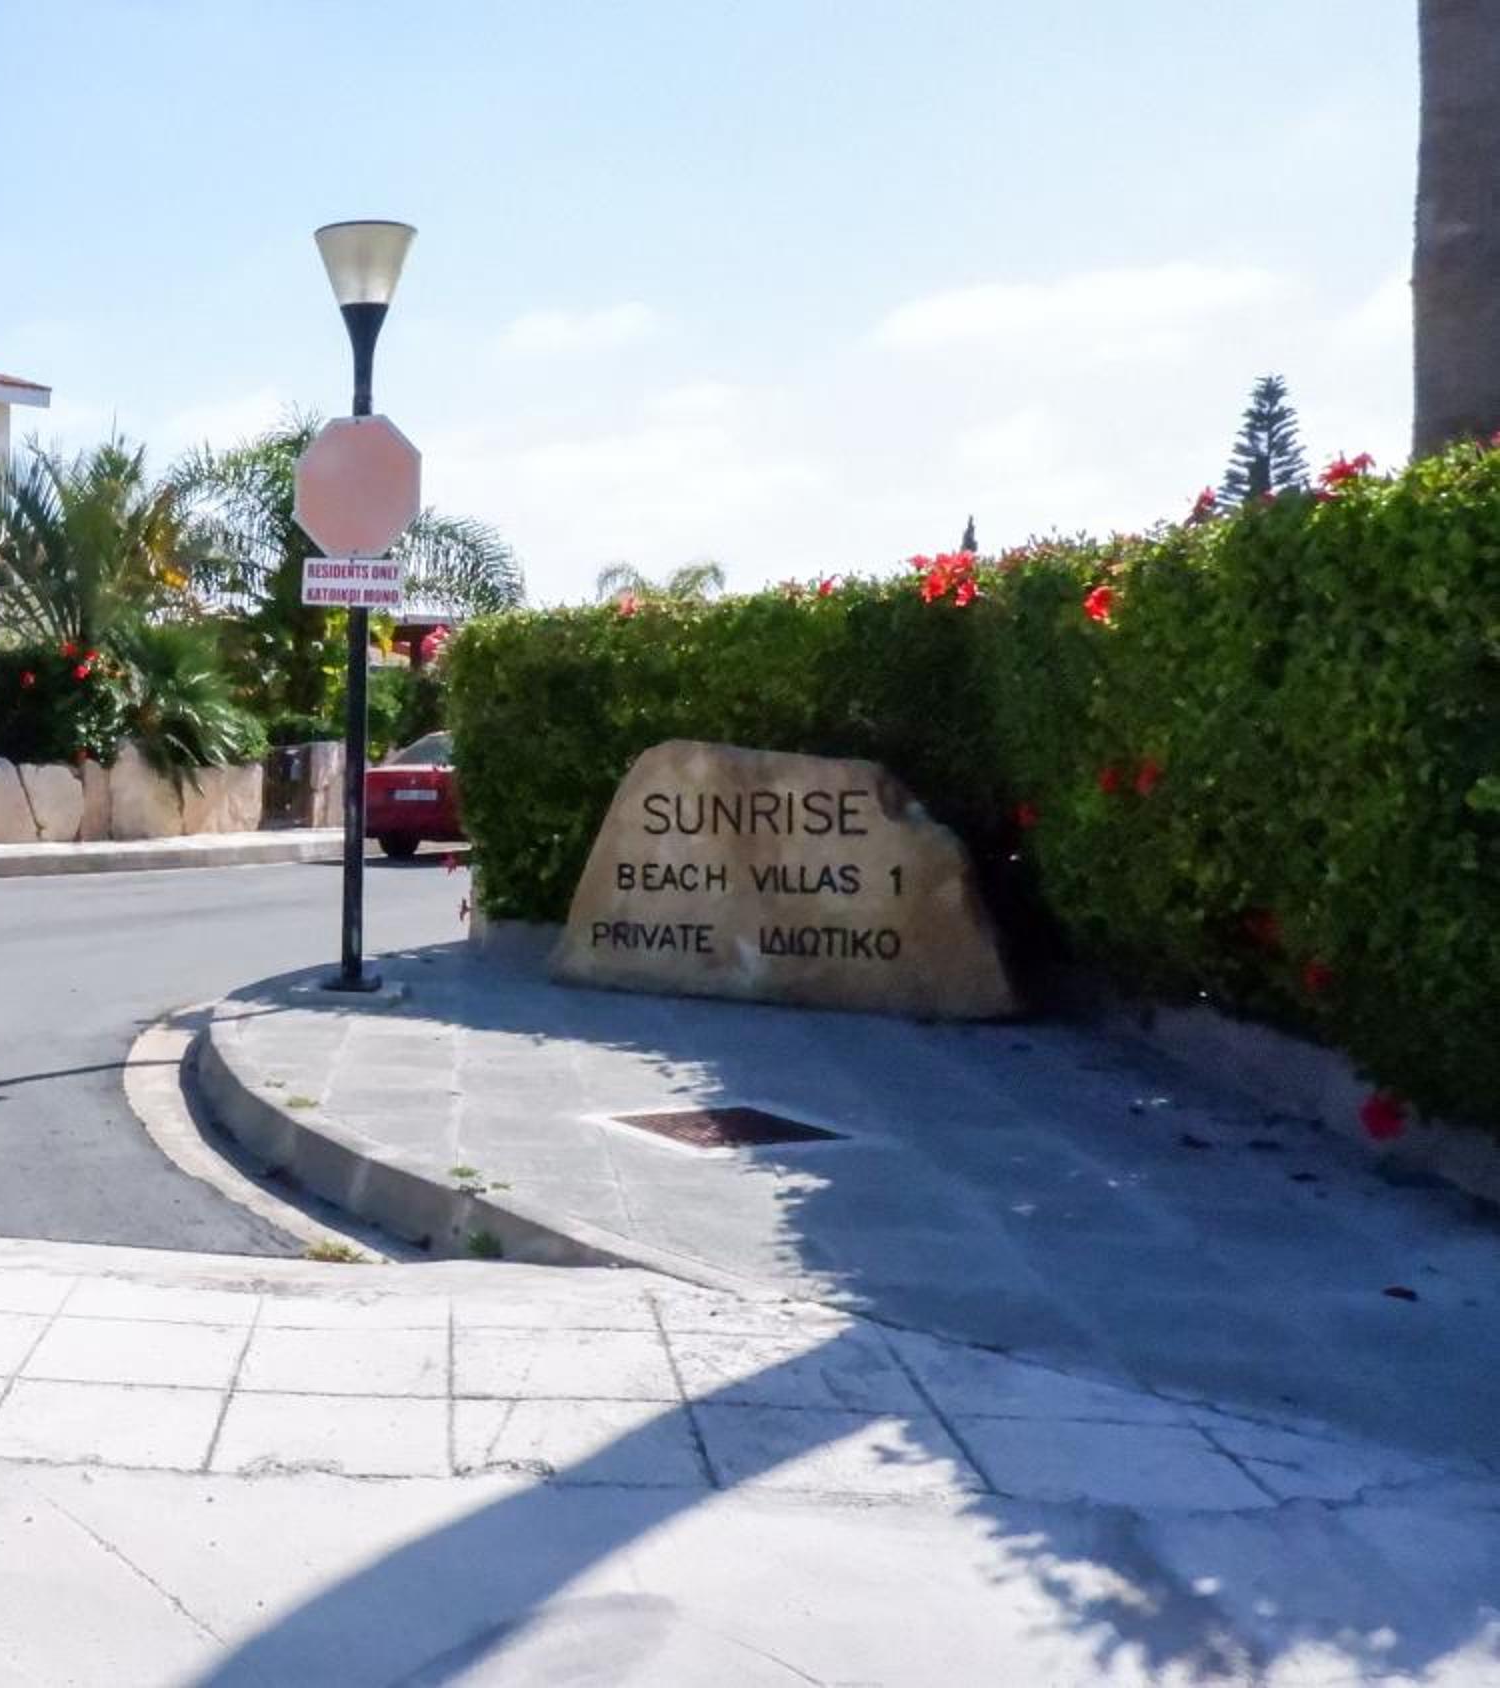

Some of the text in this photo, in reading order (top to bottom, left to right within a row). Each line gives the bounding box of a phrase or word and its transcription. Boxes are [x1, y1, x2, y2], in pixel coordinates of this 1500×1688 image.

[307, 564, 399, 580] RESIDENTS ONLY
[643, 790, 868, 836] SUNRISE
[617, 863, 902, 895] BEACH VILLAS 1
[592, 921, 714, 953] PRIVATE
[759, 926, 901, 960] ΙΔΙΩΤΙΚΟ
